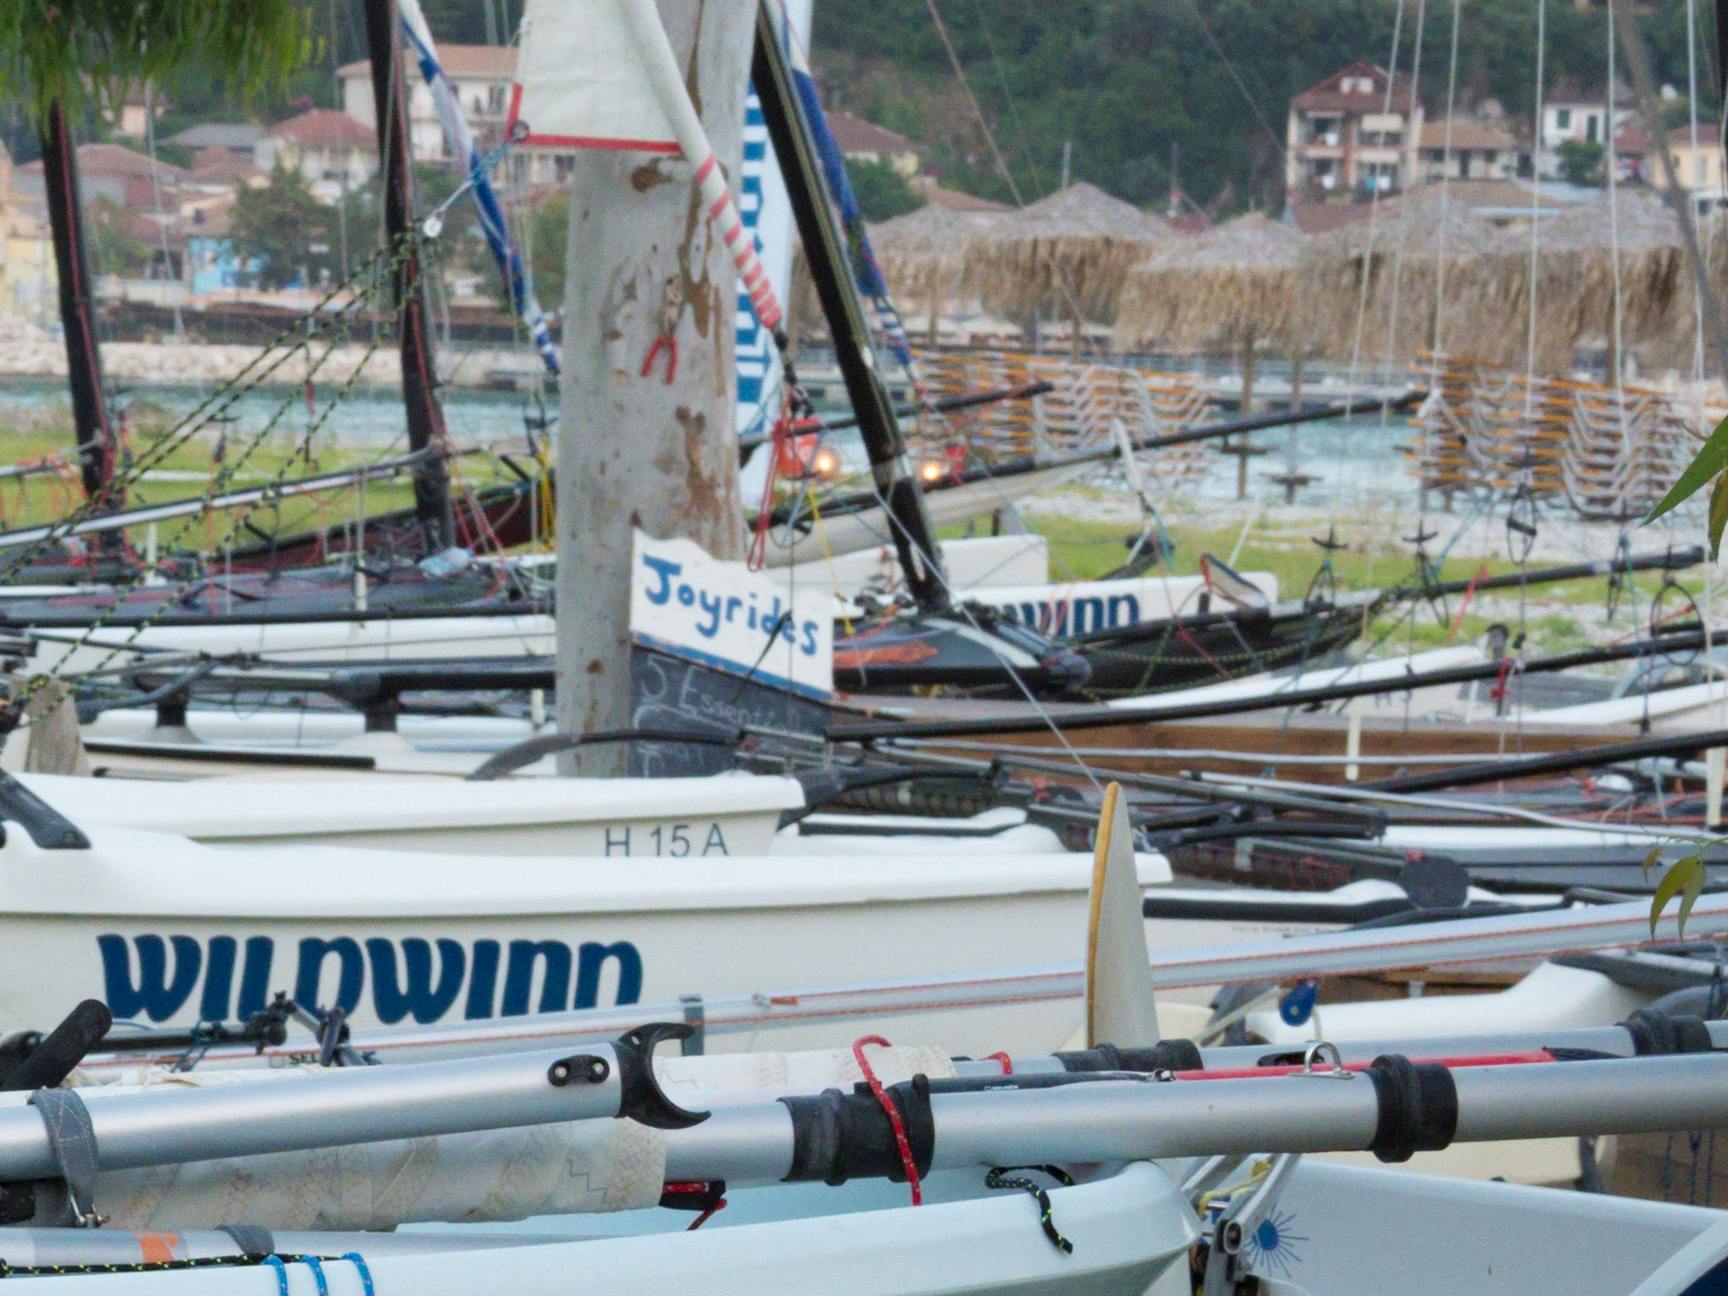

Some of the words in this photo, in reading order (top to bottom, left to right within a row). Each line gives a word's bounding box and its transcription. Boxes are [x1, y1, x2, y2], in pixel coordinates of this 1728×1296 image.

[642, 551, 819, 656] Joyrides
[604, 827, 630, 858] H
[649, 824, 691, 858] 15
[702, 822, 730, 857] A
